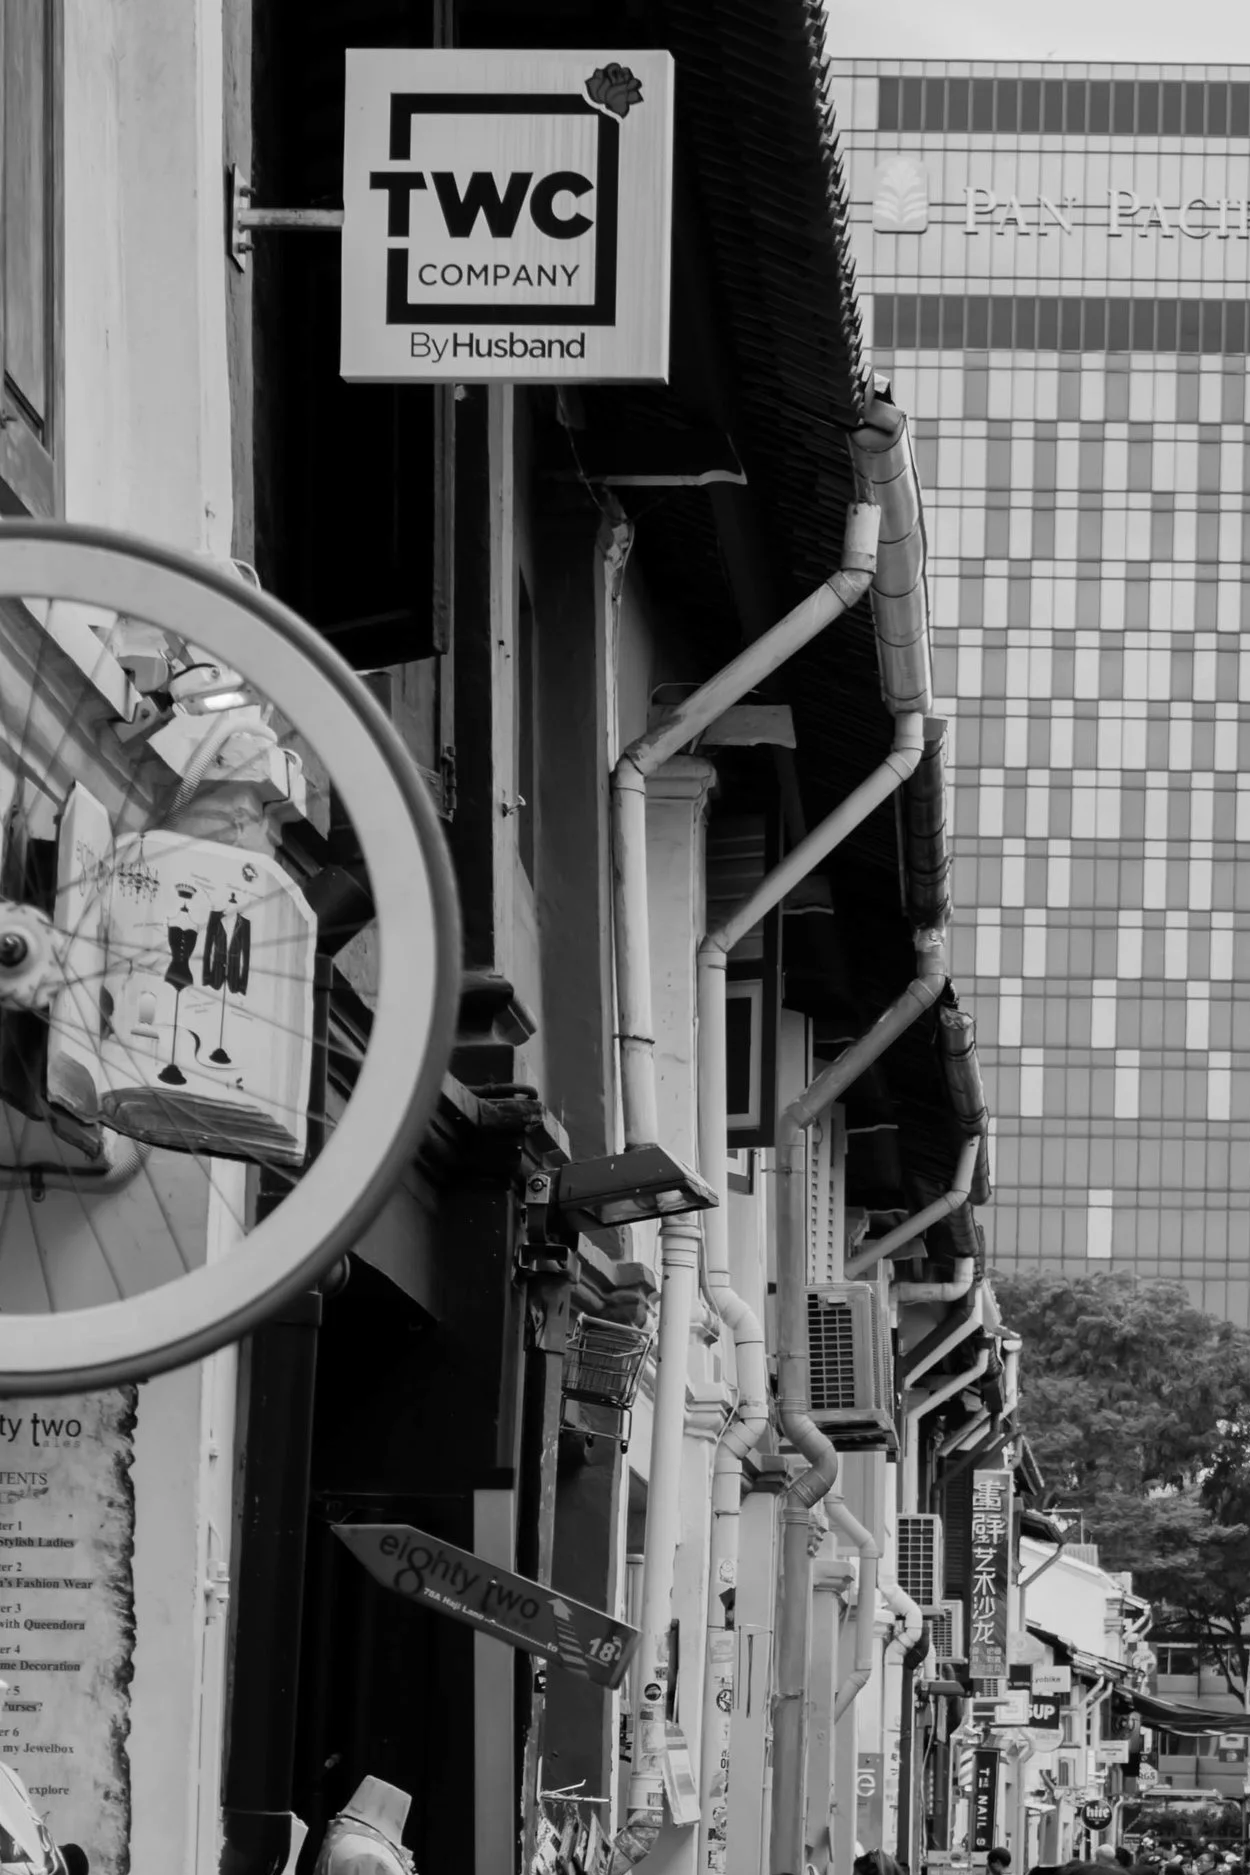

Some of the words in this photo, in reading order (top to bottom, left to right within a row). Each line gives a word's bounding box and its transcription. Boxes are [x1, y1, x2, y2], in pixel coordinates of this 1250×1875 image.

[369, 171, 595, 240] TWC
[963, 186, 1076, 236] PAN
[418, 262, 580, 288] COMPANY
[410, 331, 449, 363] By
[452, 331, 586, 360] Husband
[30, 1412, 82, 1447] two
[37, 1537, 75, 1548] Ladies
[16, 1562, 23, 1572] 2
[15, 1578, 60, 1589] Fashion
[63, 1578, 94, 1589] Wear
[379, 1534, 482, 1596] eighty
[480, 1574, 541, 1620] two
[14, 1603, 22, 1613] 3
[23, 1618, 86, 1632] Queendora
[14, 1644, 21, 1654] 4
[20, 1660, 81, 1672] Decoration
[12, 1727, 20, 1737] 6
[3, 1745, 19, 1756] my
[23, 1742, 74, 1754] Jewelbox
[28, 1785, 70, 1798] explore
[976, 1795, 989, 1829] NAIL
